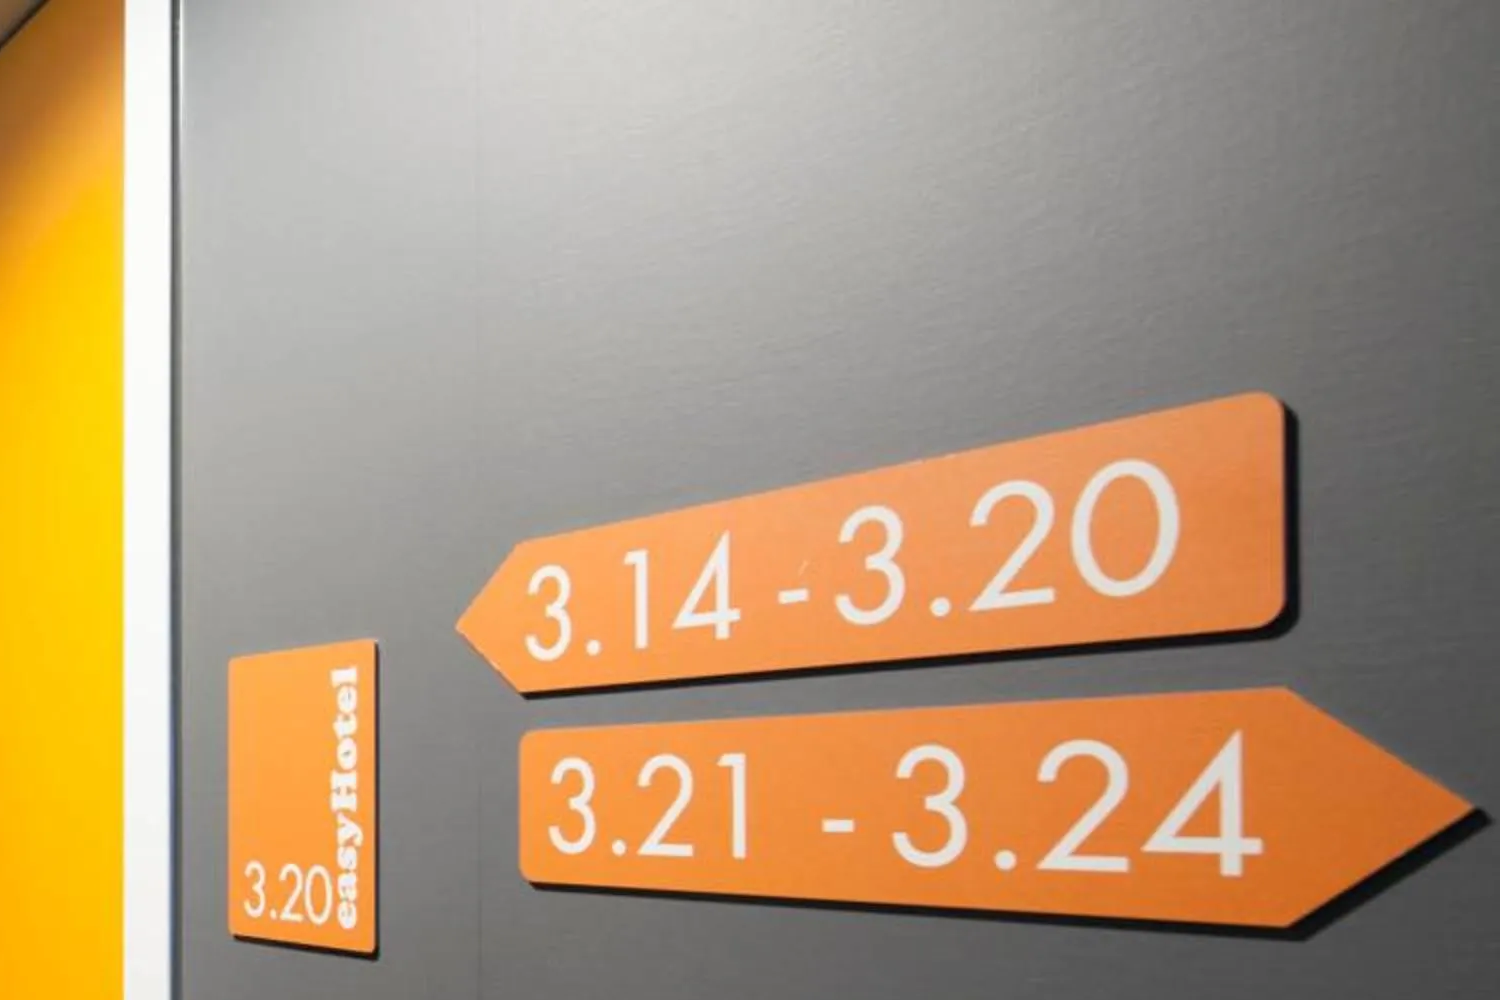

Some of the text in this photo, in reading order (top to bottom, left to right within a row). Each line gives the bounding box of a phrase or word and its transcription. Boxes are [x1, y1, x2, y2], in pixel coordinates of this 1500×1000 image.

[524, 530, 742, 662] 3.14
[835, 458, 1181, 626] 3.20
[329, 665, 364, 930] easyHotel
[547, 751, 748, 860] 3.21
[892, 731, 1264, 877] 3.24
[243, 860, 333, 925] 3.20
